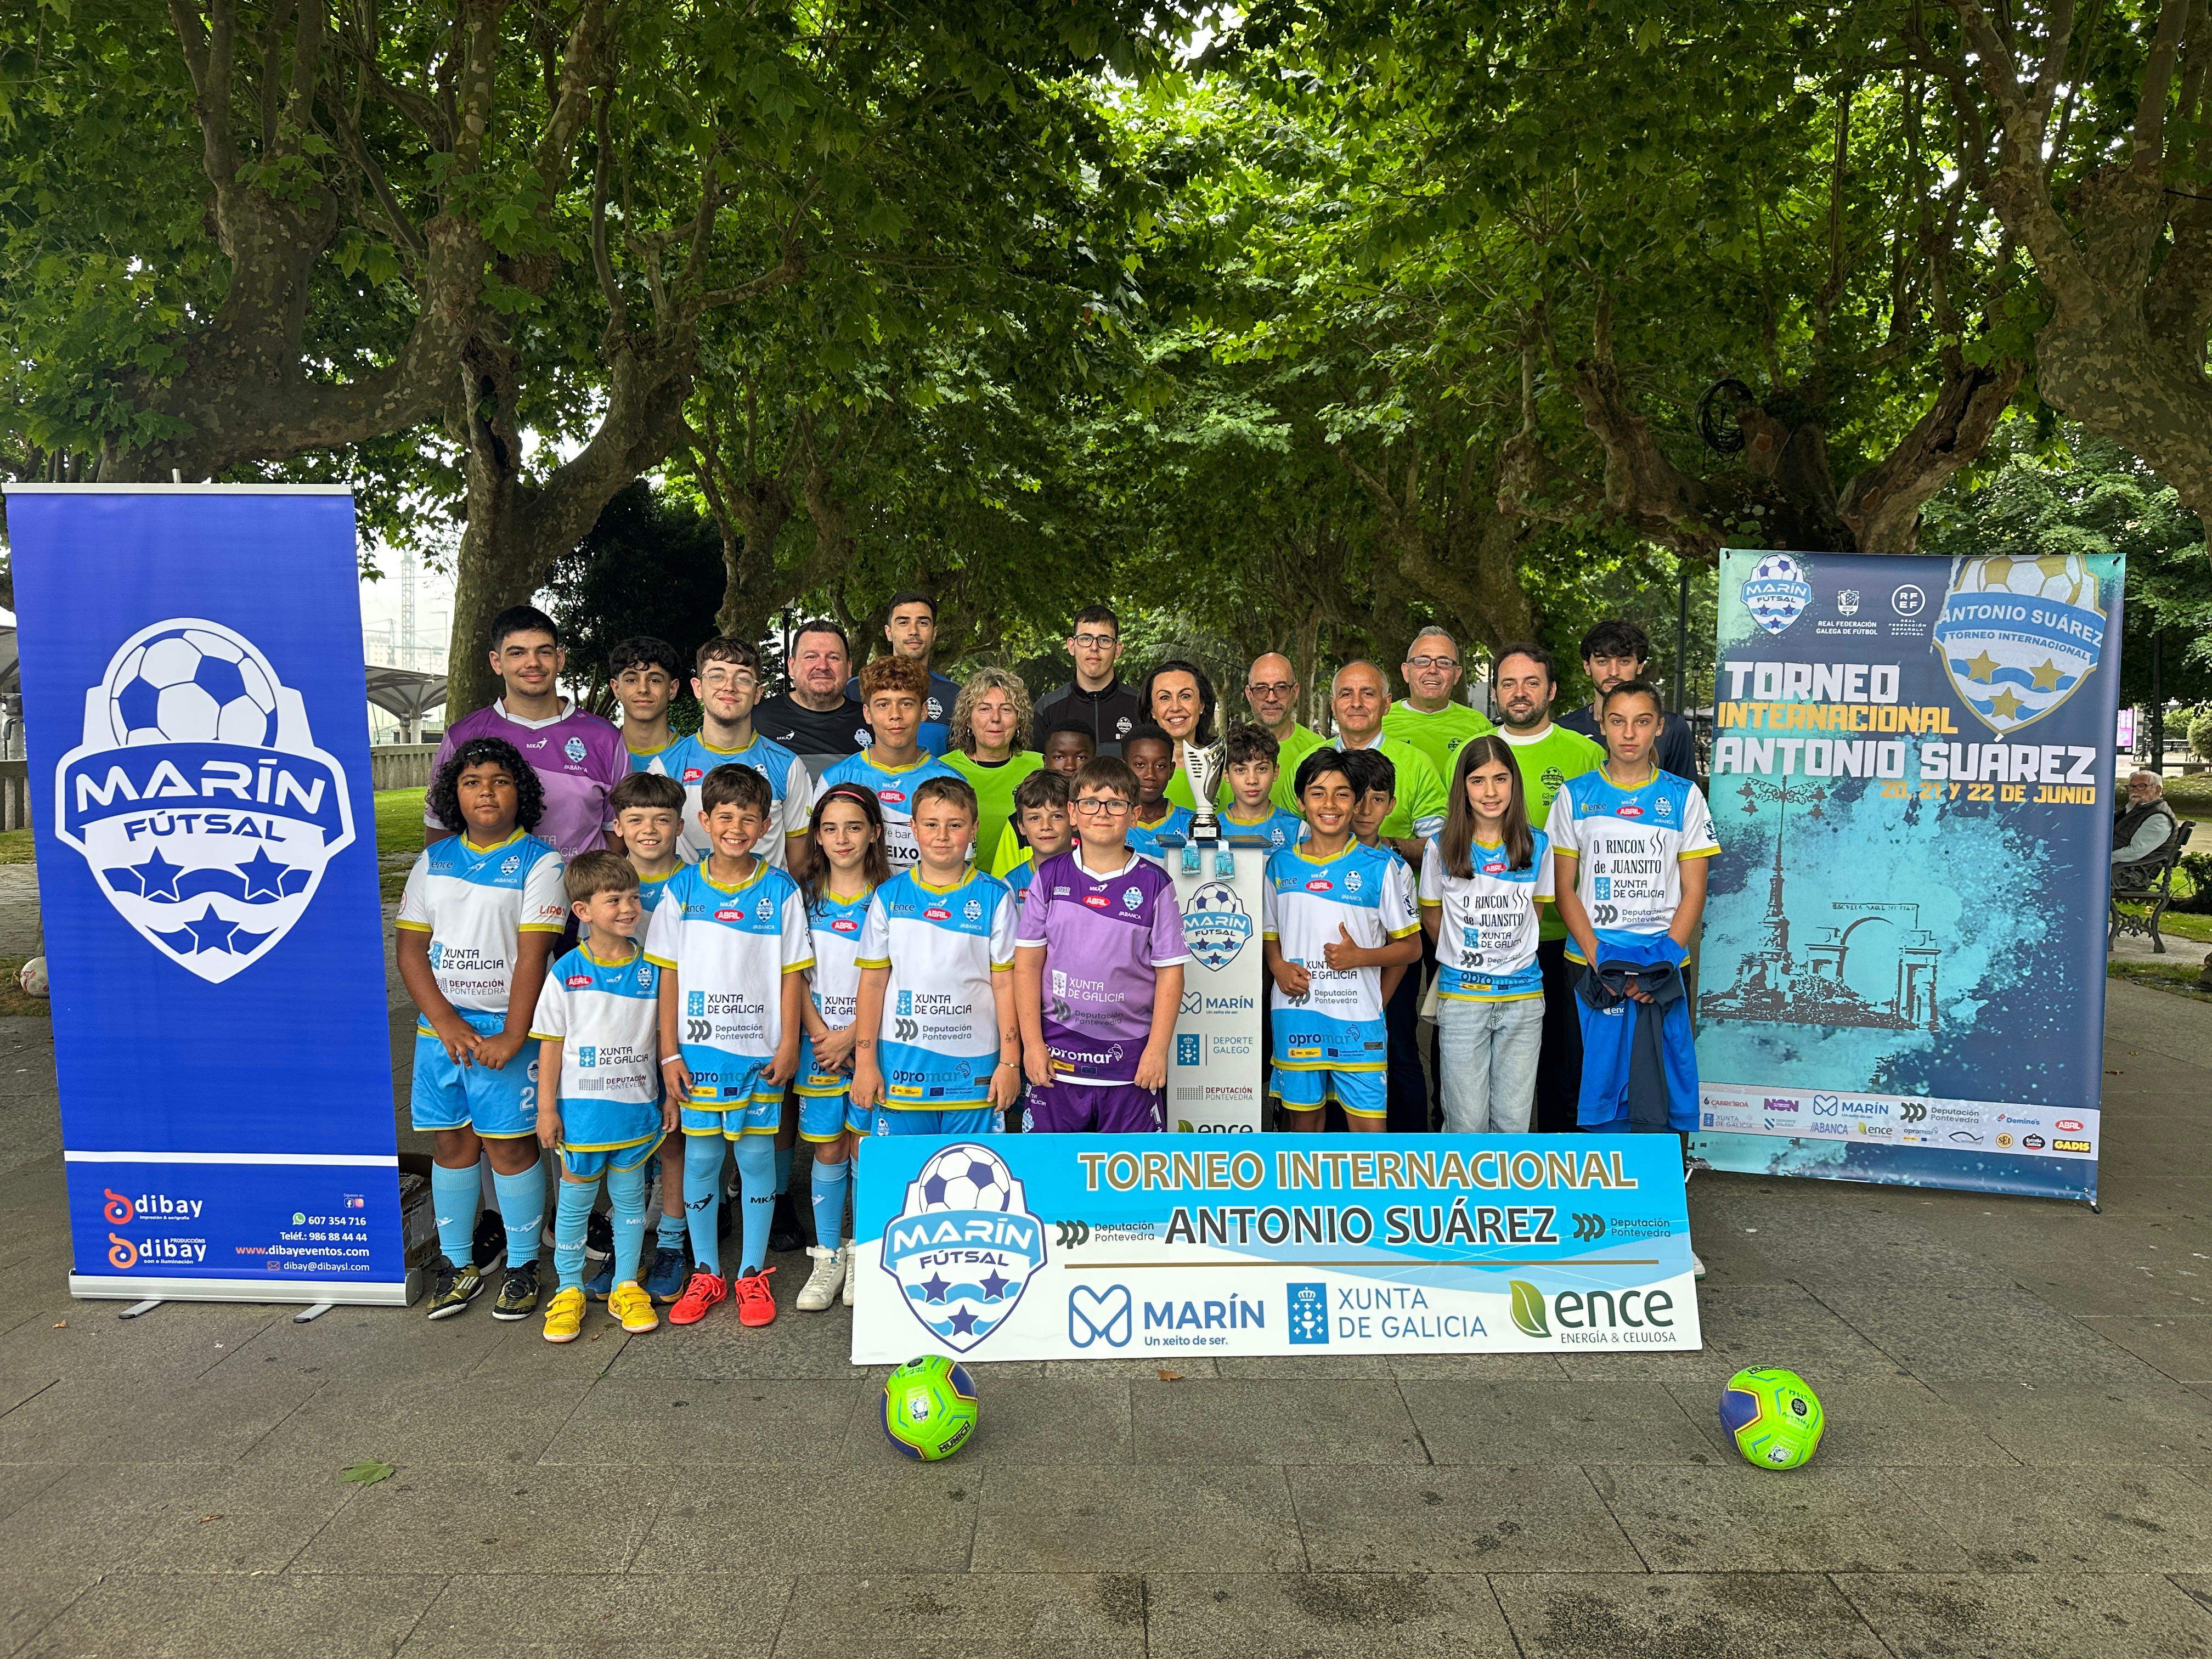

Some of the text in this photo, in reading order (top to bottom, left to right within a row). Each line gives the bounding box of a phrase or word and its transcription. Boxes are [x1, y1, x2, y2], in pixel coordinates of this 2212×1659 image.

[1746, 583, 1807, 596] MARÍN
[1940, 605, 2103, 647] ANTONIO SUÁREZ
[1999, 633, 2089, 660] INTERNACIONAL
[1724, 661, 1900, 703] TORNEO
[1717, 703, 1958, 735] INTERNACIONAL
[1714, 733, 2096, 786] ANTONIO SUÁREZ
[76, 758, 326, 814] MARÍN
[880, 792, 902, 802] ABRIL
[1881, 782, 2095, 805] 20, 21 Y 22 DE JUNIO
[123, 811, 286, 842] FÚTSAL
[896, 829, 911, 838] bar
[1594, 840, 1645, 854] O RINCON
[1594, 860, 1661, 874] de JUANSITO
[1629, 890, 1664, 898] GALICIA
[1086, 897, 1107, 905] ABRIL
[1463, 895, 1509, 909] O RINCON
[927, 910, 947, 918] ABRIL
[1183, 915, 1246, 930] MARÍN
[1464, 913, 1523, 927] de JUANSITO
[1195, 928, 1235, 936] FÚTSAL
[444, 949, 479, 958] XUNTA
[443, 959, 504, 970] DE GALICIA
[1319, 970, 1357, 979] GALICIA
[449, 979, 504, 988] DEPUTACIÓN
[1069, 978, 1104, 991] XUNTA
[450, 987, 505, 995] PONTEVEDRA
[1068, 989, 1124, 1002] DE GALICIA
[1314, 989, 1357, 998] Deputación
[708, 994, 743, 1003] XUNTA
[916, 995, 951, 1003] XUNTA
[1206, 995, 1253, 1008] MARÍN
[708, 1005, 764, 1014] DE GALICIA
[915, 1005, 972, 1014] DE GALICIA
[1075, 1010, 1124, 1019] Deputación
[715, 1024, 763, 1034] Deputación
[923, 1024, 972, 1034] Deputación
[600, 1047, 633, 1056] XUNTA
[615, 1055, 648, 1063] GALICIA
[1206, 1085, 1252, 1093] DEPUTACIÓN
[1764, 1098, 1799, 1112] NON
[1842, 1102, 1888, 1114] MARÍN
[1931, 1108, 1979, 1116] Deputación
[1931, 1115, 1979, 1124] Pontevedra
[1869, 1126, 1892, 1135] ence
[2058, 1121, 2081, 1130] ABRIL
[1998, 1136, 2010, 1144] SEI
[2054, 1141, 2090, 1151] GADIS
[1079, 1150, 1638, 1191] TORNEO INTERNACIONAL
[135, 1194, 202, 1217] dibay
[308, 1216, 366, 1226] 607 354 716
[1165, 1197, 1558, 1245] ANTONIO SUÁREZ
[1611, 1216, 1670, 1229] Deputación
[1095, 1221, 1154, 1233] Deputación
[1611, 1227, 1671, 1238] Pontevedra
[280, 1232, 367, 1242] Teléf.: 986 88 44 44
[893, 1218, 1034, 1253] MARÍN
[1095, 1232, 1154, 1242] Pontevedra
[139, 1239, 206, 1262] dibay
[235, 1245, 369, 1257] www.dibayeventos.com
[919, 1249, 1010, 1270] FÚTSAL
[284, 1262, 369, 1272] dibay@dibaysl.com
[1339, 1288, 1429, 1310] XUNTA
[1144, 1293, 1265, 1330] MARÍN
[1555, 1290, 1674, 1328] ence
[1339, 1316, 1488, 1338] DE GALICIA
[1144, 1335, 1228, 1346] Un xeito de ser.
[1561, 1330, 1676, 1343] ENERGÍA & CELULOSA
